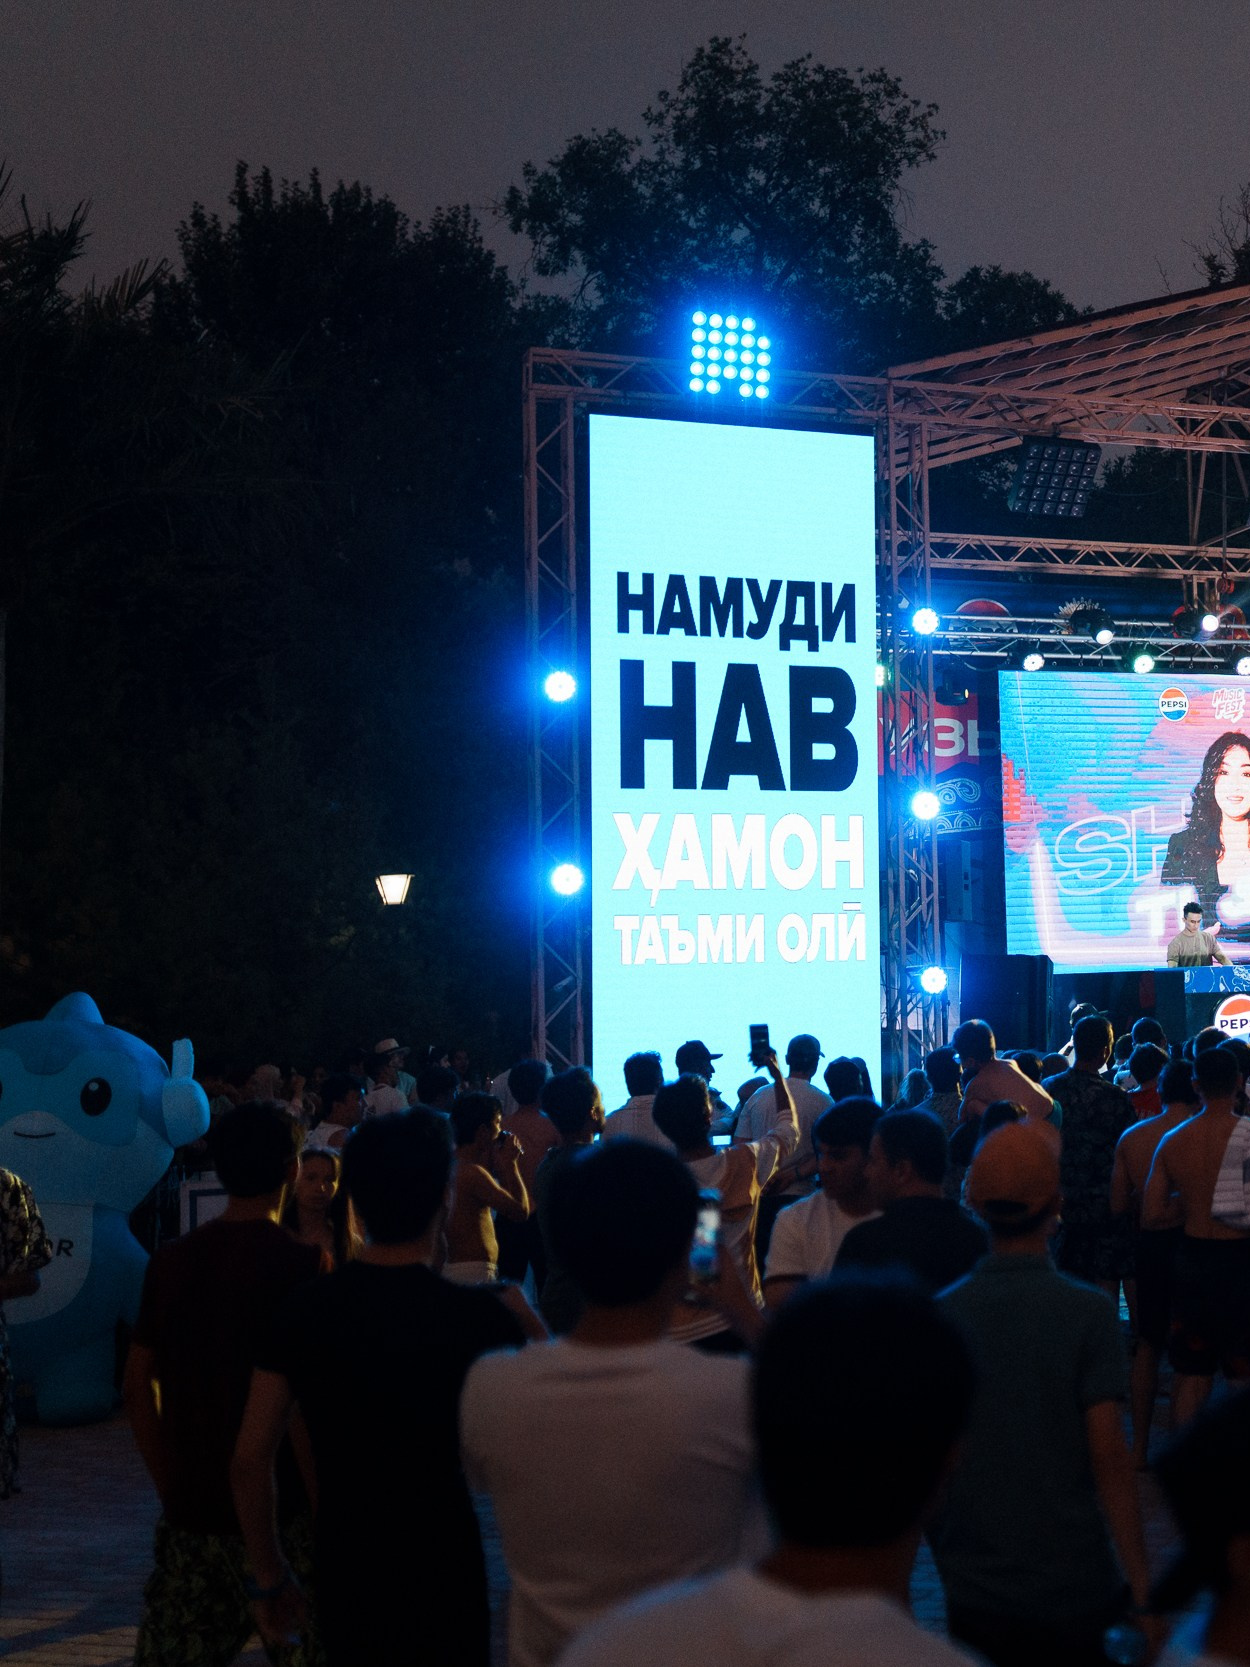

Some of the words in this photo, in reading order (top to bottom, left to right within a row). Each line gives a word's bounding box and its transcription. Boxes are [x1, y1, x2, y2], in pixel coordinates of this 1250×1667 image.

[616, 571, 857, 653] НАМУДИ
[1160, 700, 1188, 709] PEPSI
[1213, 688, 1243, 705] MUSIC
[1216, 699, 1243, 717] FEST
[619, 658, 859, 792] НАВ
[611, 811, 865, 908] ҲАМОН
[613, 913, 765, 966] ТАЪМИ
